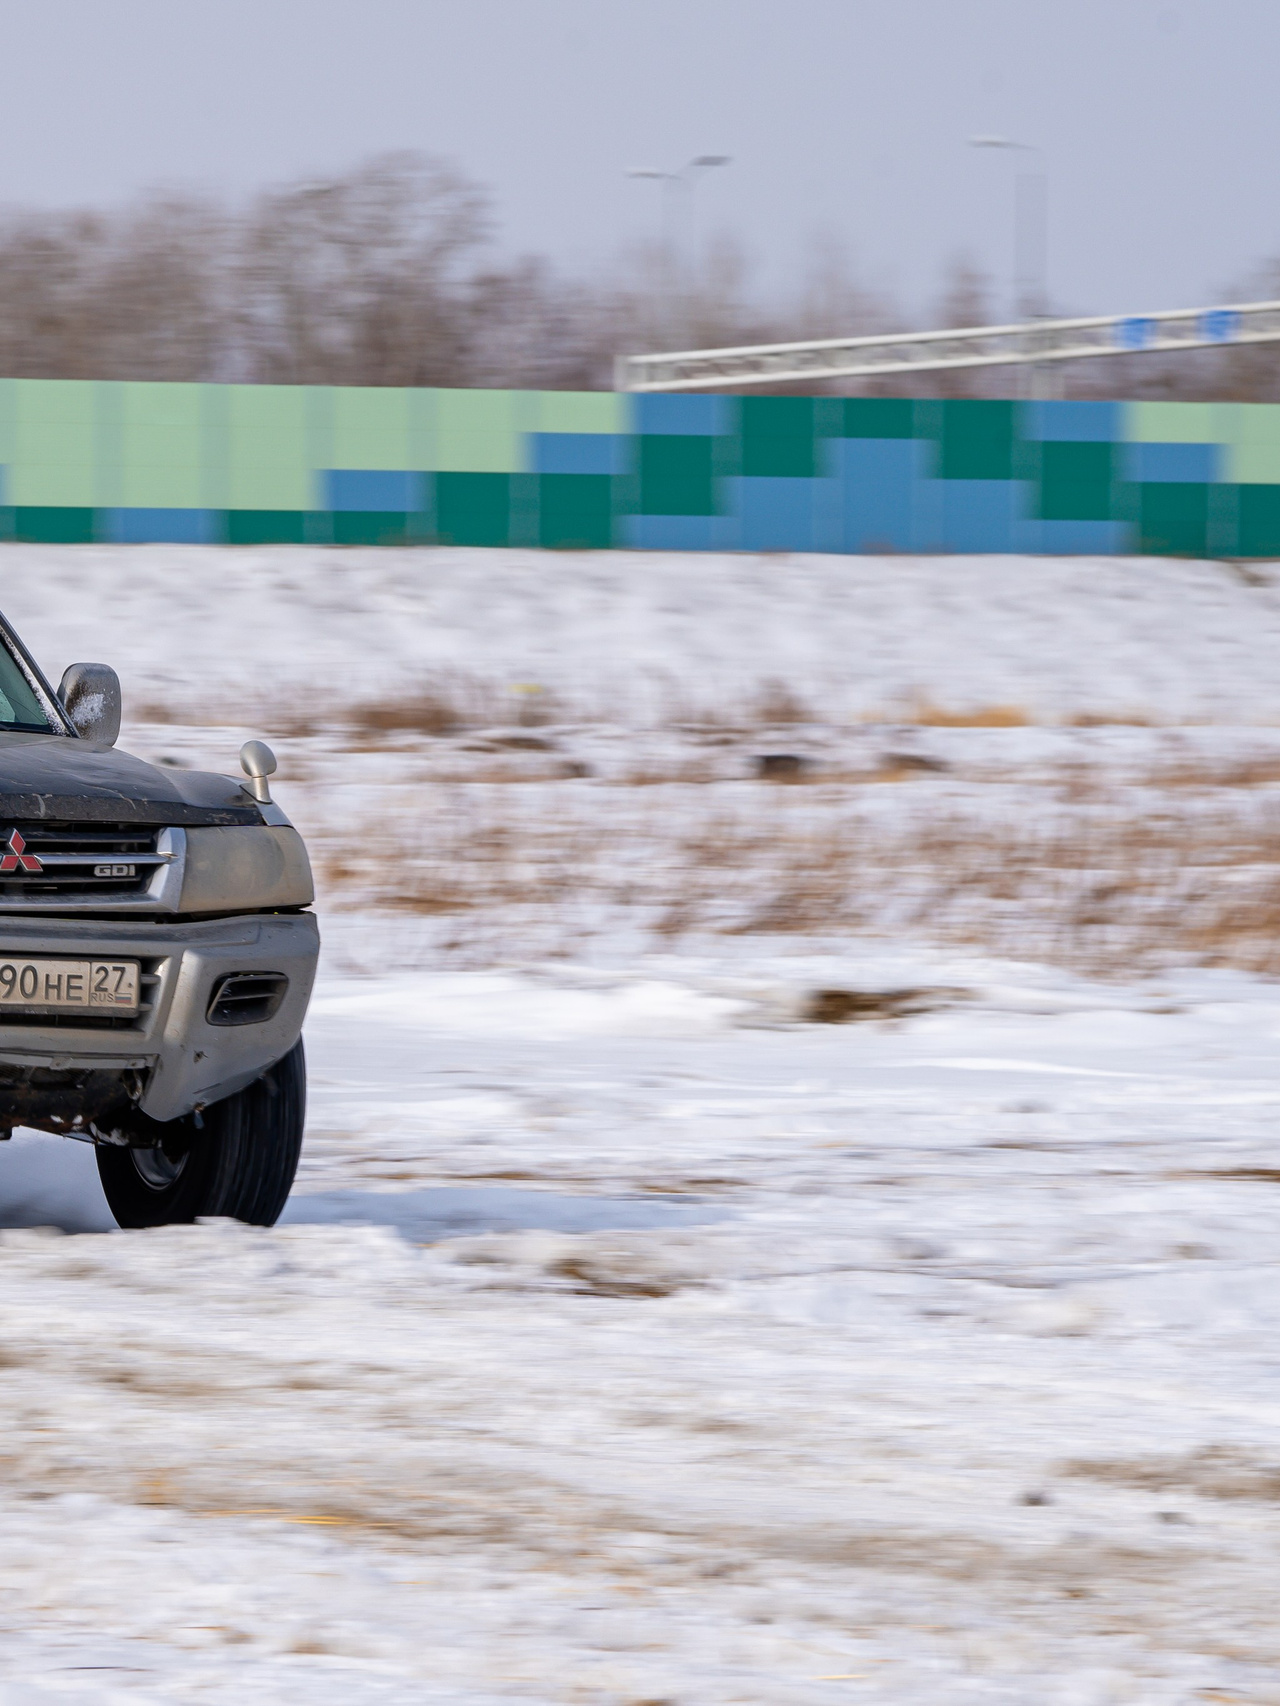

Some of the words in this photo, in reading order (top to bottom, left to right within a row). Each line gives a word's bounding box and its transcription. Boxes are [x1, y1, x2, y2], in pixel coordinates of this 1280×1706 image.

[94, 865, 136, 877] GDI
[94, 966, 126, 992] 27
[91, 992, 114, 1003] RUS
